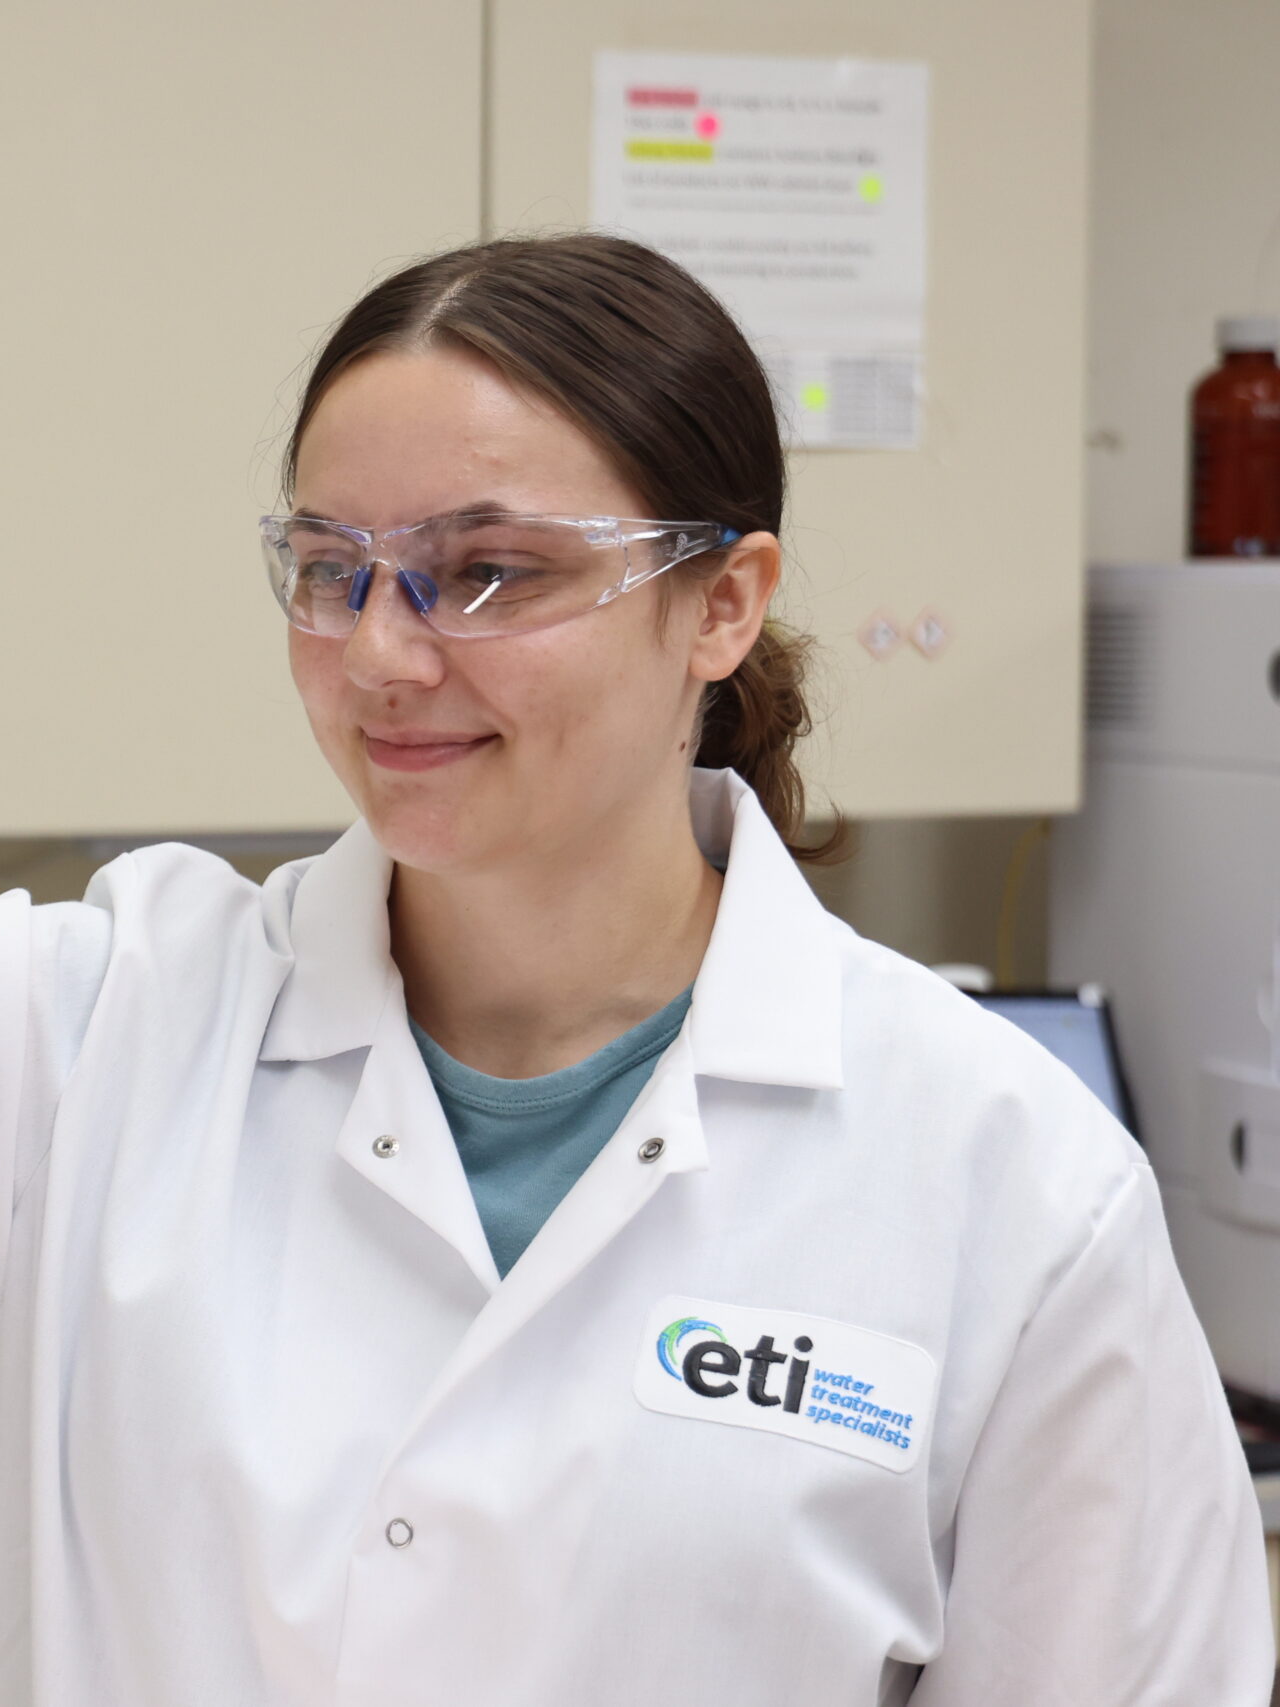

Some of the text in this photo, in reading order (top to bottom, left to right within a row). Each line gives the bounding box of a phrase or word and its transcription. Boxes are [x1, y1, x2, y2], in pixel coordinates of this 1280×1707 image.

[682, 1335, 813, 1414] eti
[814, 1369, 875, 1396] water
[805, 1404, 912, 1450] specialists
[810, 1384, 913, 1431] treatment
